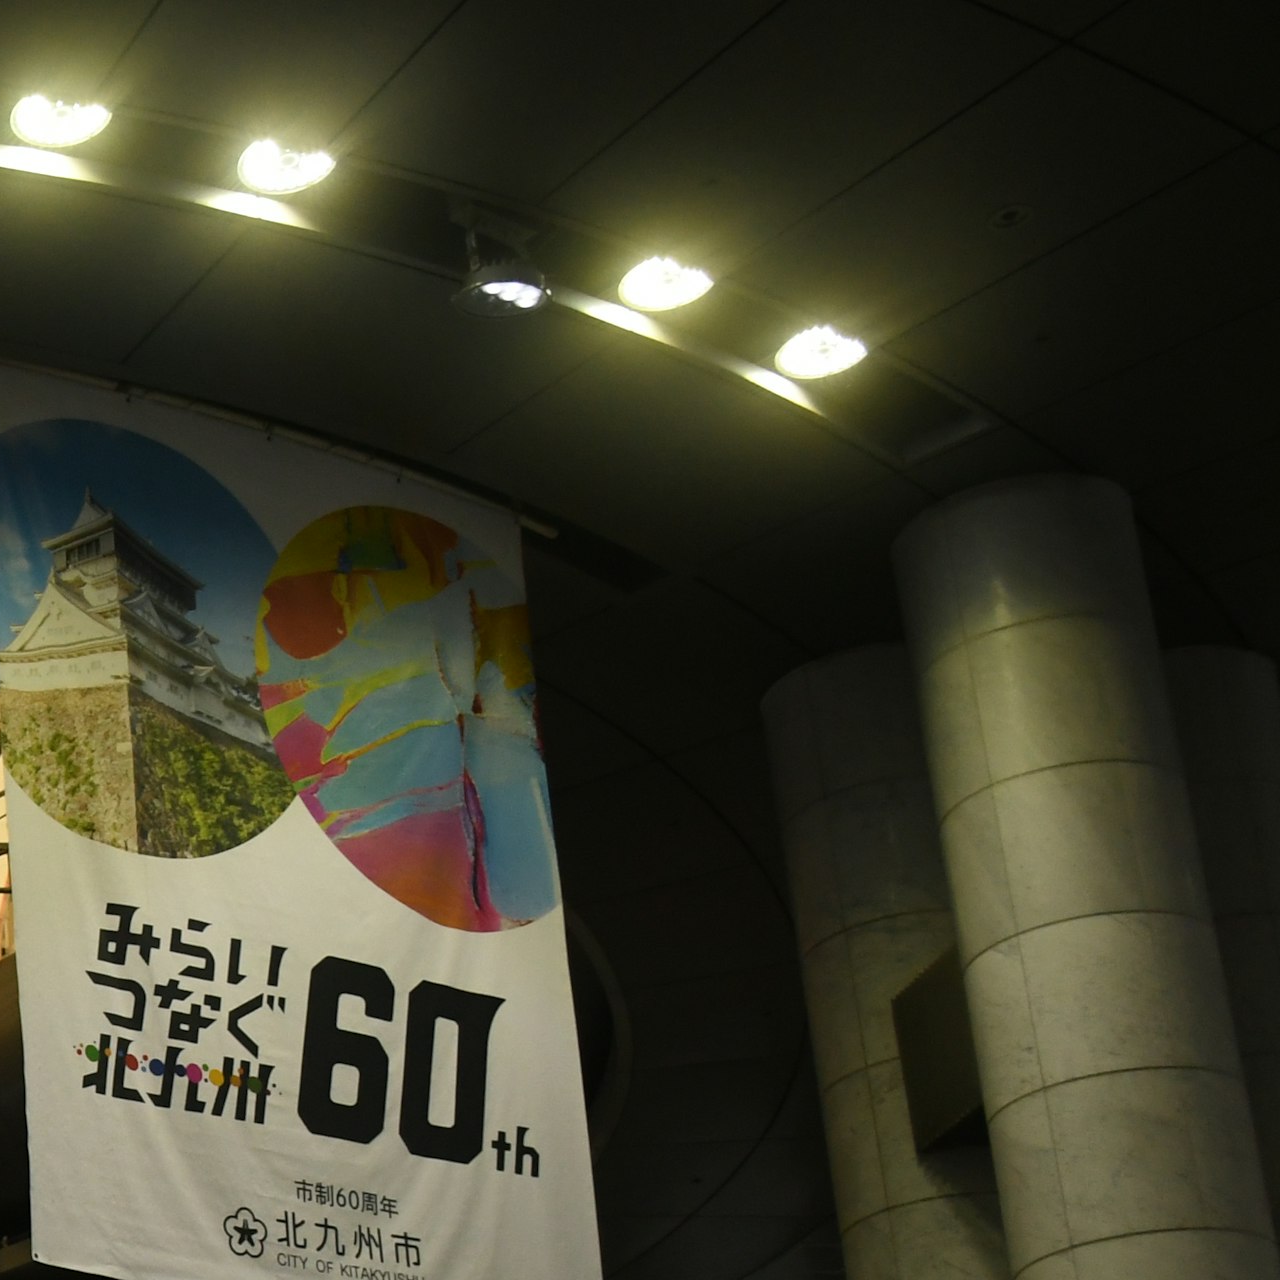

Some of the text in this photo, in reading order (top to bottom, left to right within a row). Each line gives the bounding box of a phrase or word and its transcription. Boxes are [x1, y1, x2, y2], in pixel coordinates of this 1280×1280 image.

[96, 902, 288, 987] みらい
[85, 970, 287, 1058] つなぐ
[82, 1033, 274, 1124] 北九州
[297, 955, 540, 1178] 60th
[276, 1210, 421, 1267] 北九州市
[294, 1179, 399, 1219] 市制60周年
[276, 1252, 308, 1270] CITY
[315, 1259, 334, 1274] OF
